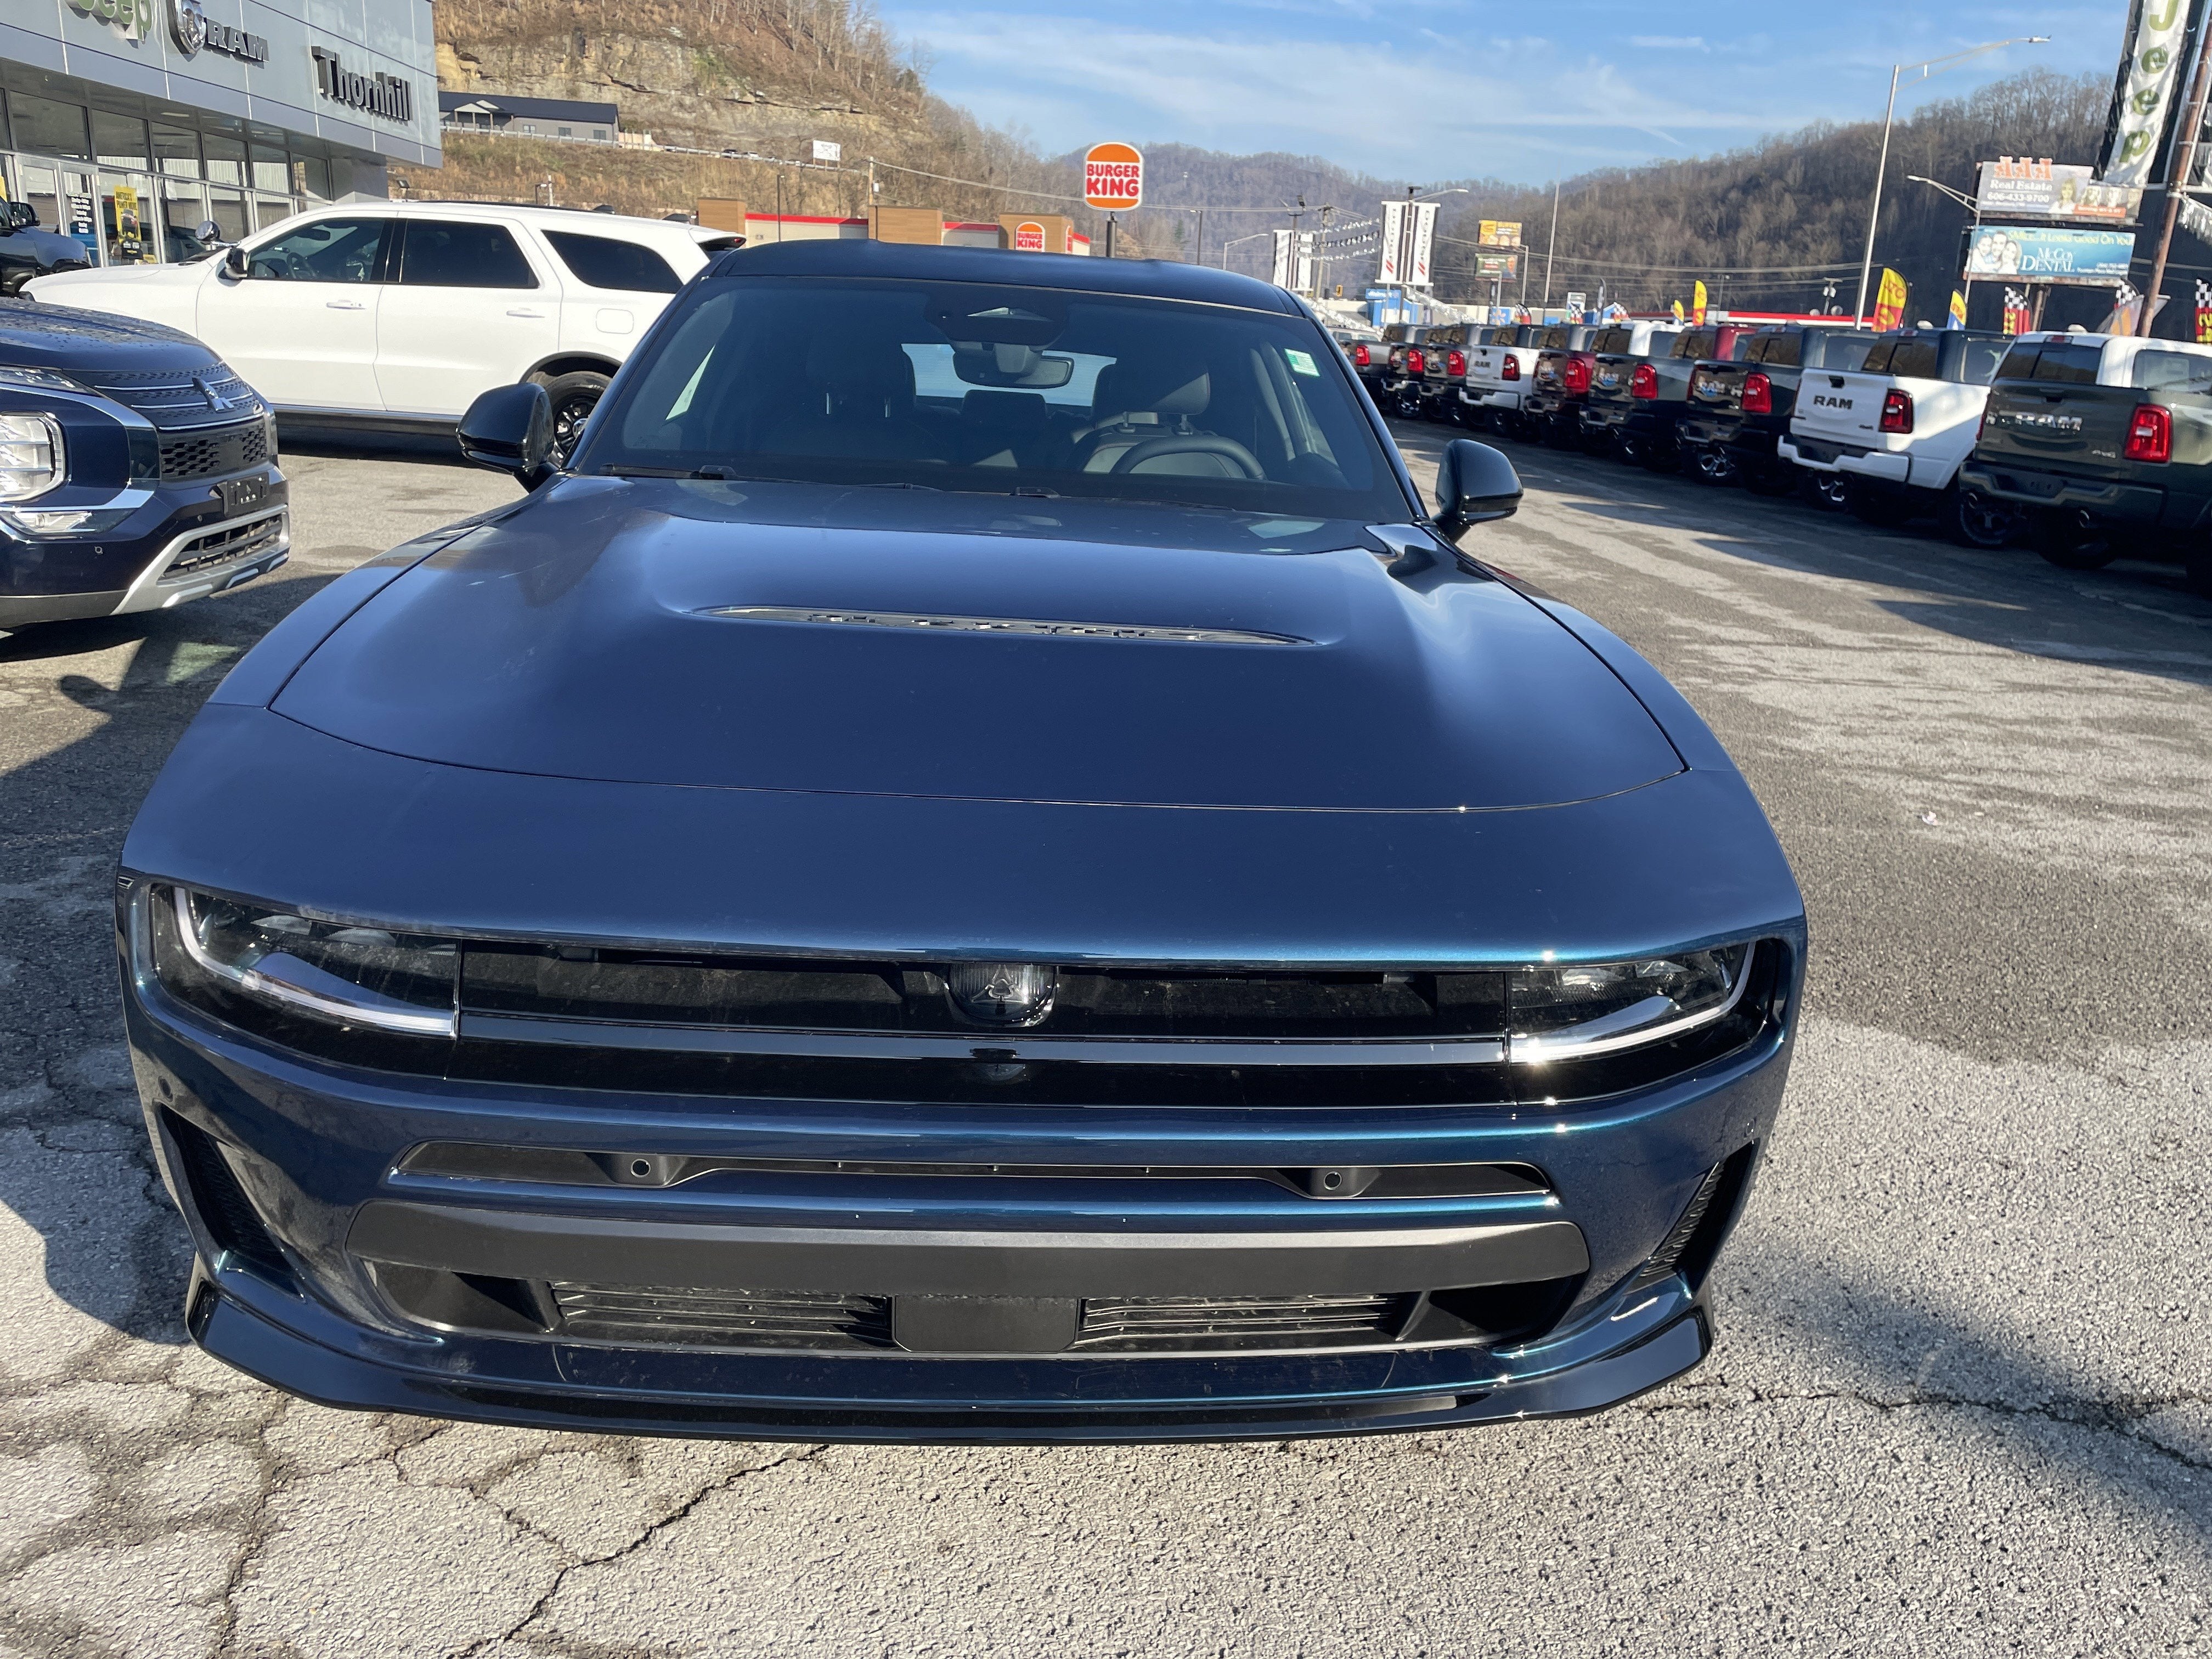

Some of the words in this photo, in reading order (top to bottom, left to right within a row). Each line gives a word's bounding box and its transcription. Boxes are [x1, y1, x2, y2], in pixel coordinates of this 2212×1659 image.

[75, 0, 154, 41] eep
[205, 16, 269, 63] RAM
[311, 46, 413, 121] Thornhill
[1086, 163, 1139, 178] BURGER
[1086, 177, 1139, 197] KING
[1990, 179, 2015, 189] Real
[2016, 180, 2053, 191] Estate
[1017, 239, 1042, 249] KING
[2100, 233, 2114, 245] On
[1813, 394, 1853, 410] RAM
